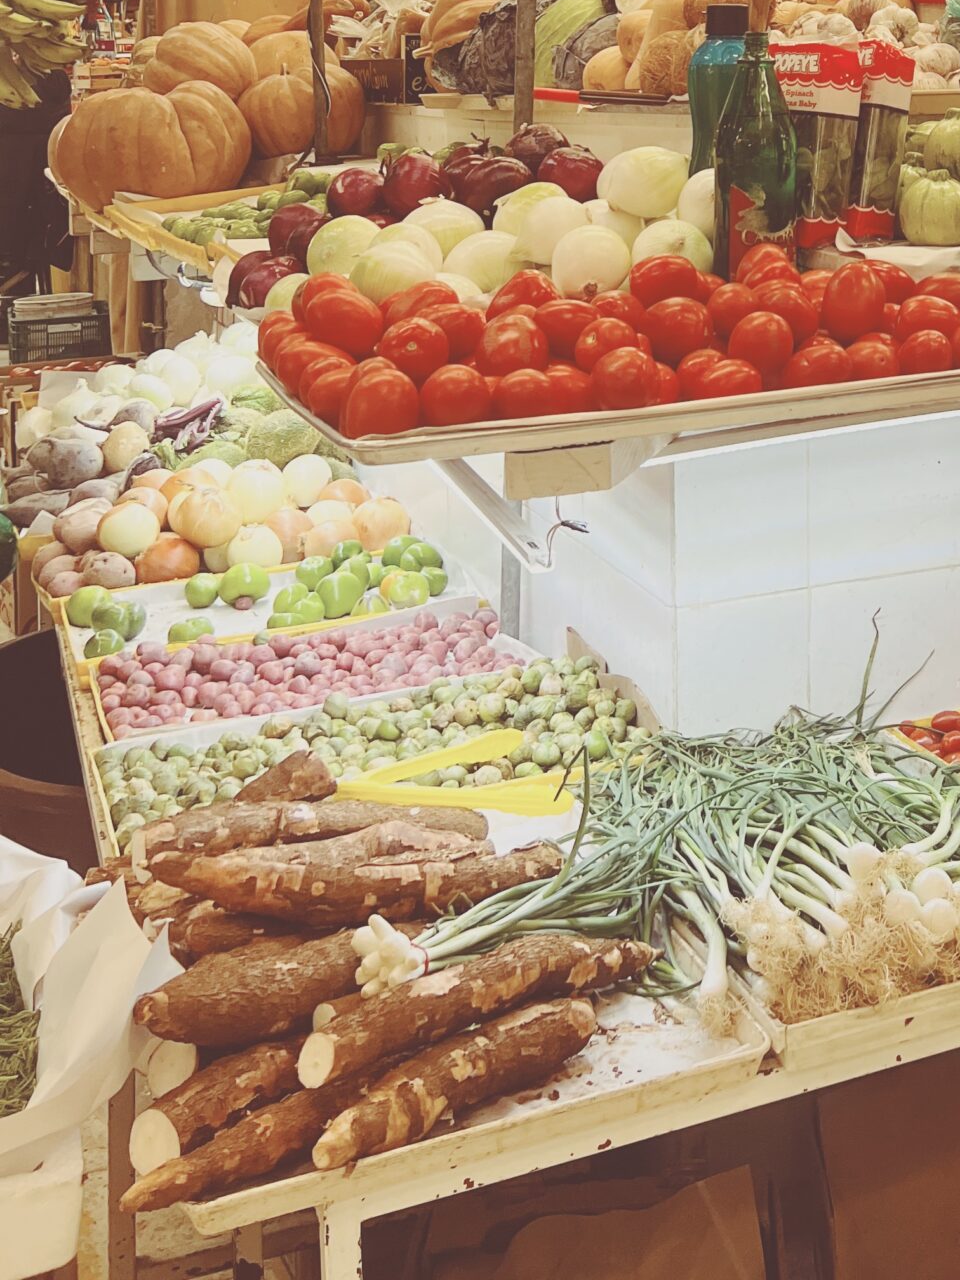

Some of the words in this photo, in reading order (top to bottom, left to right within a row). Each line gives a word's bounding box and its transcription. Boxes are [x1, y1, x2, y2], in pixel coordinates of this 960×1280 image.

[774, 52, 821, 74] POPEYE
[786, 89, 814, 98] Spinach
[798, 100, 817, 109] Baby
